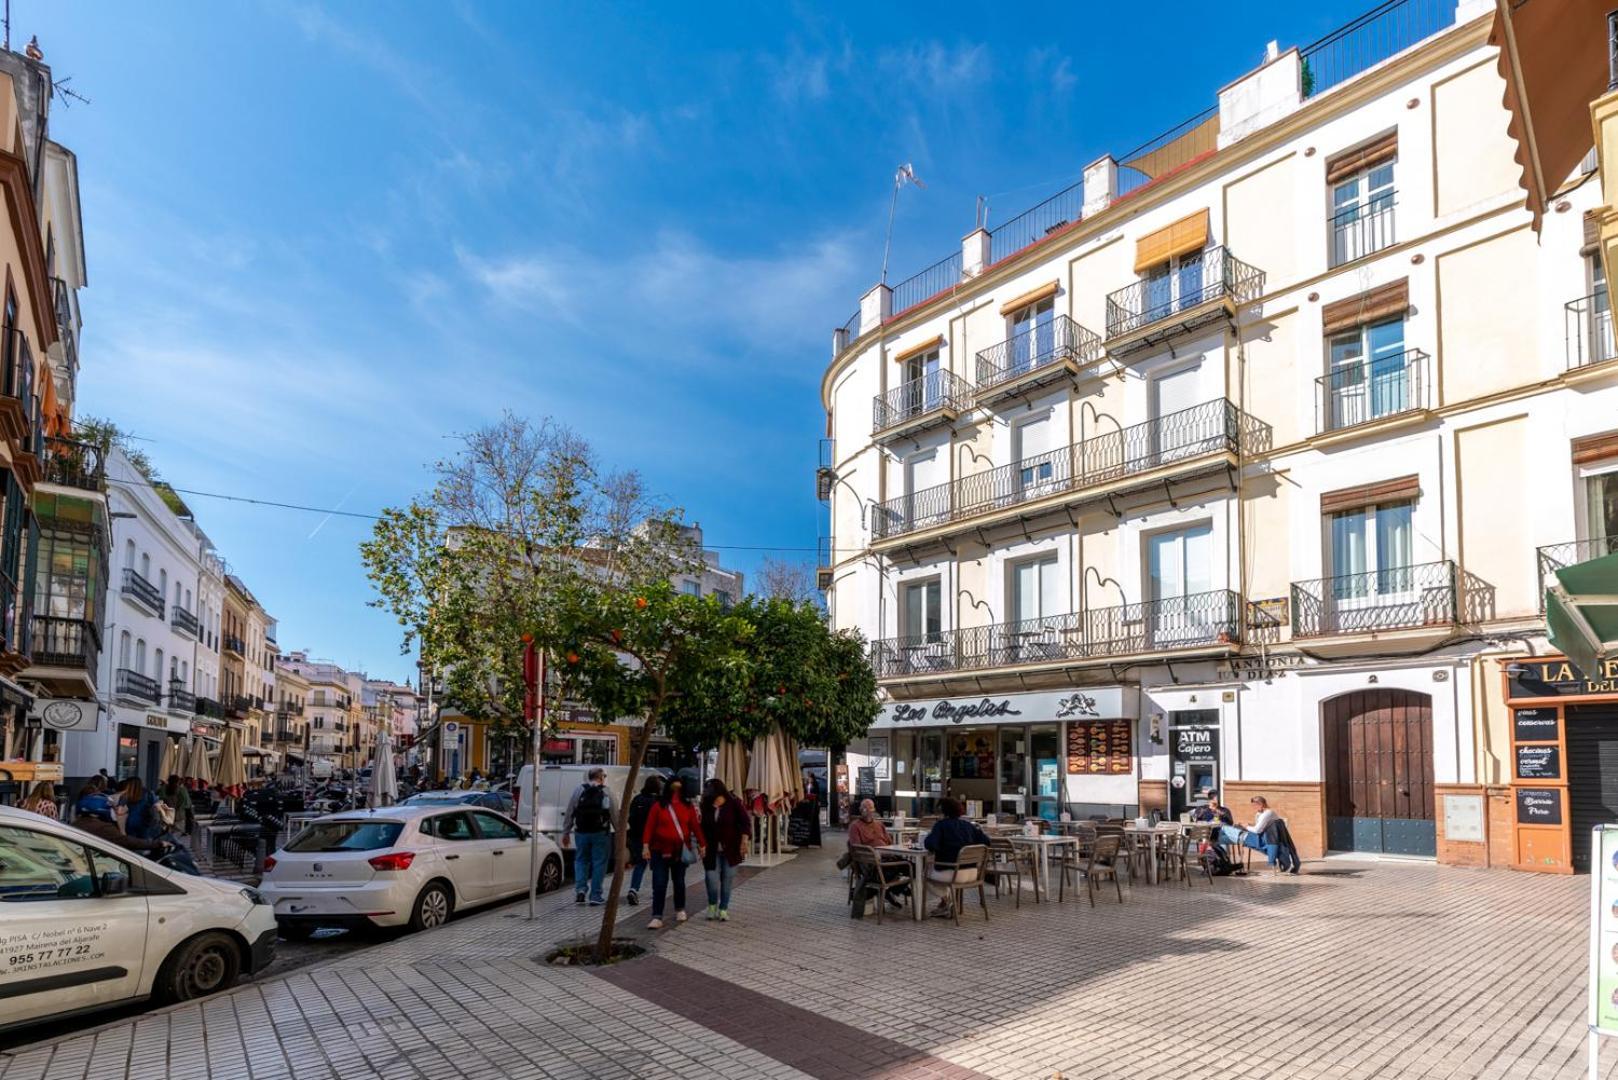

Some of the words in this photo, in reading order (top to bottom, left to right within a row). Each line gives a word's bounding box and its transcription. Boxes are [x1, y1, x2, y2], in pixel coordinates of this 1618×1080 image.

[1541, 663, 1575, 682] LA
[1368, 674, 1379, 683] 2
[1189, 695, 1197, 703] 4
[892, 704, 927, 722] Los
[932, 698, 1022, 724] Angeles
[1180, 731, 1210, 742] ATM
[1178, 743, 1211, 754] Cajero
[9, 953, 34, 966] 955
[38, 949, 54, 961] 77
[57, 946, 73, 958] 77
[75, 944, 91, 955] 22
